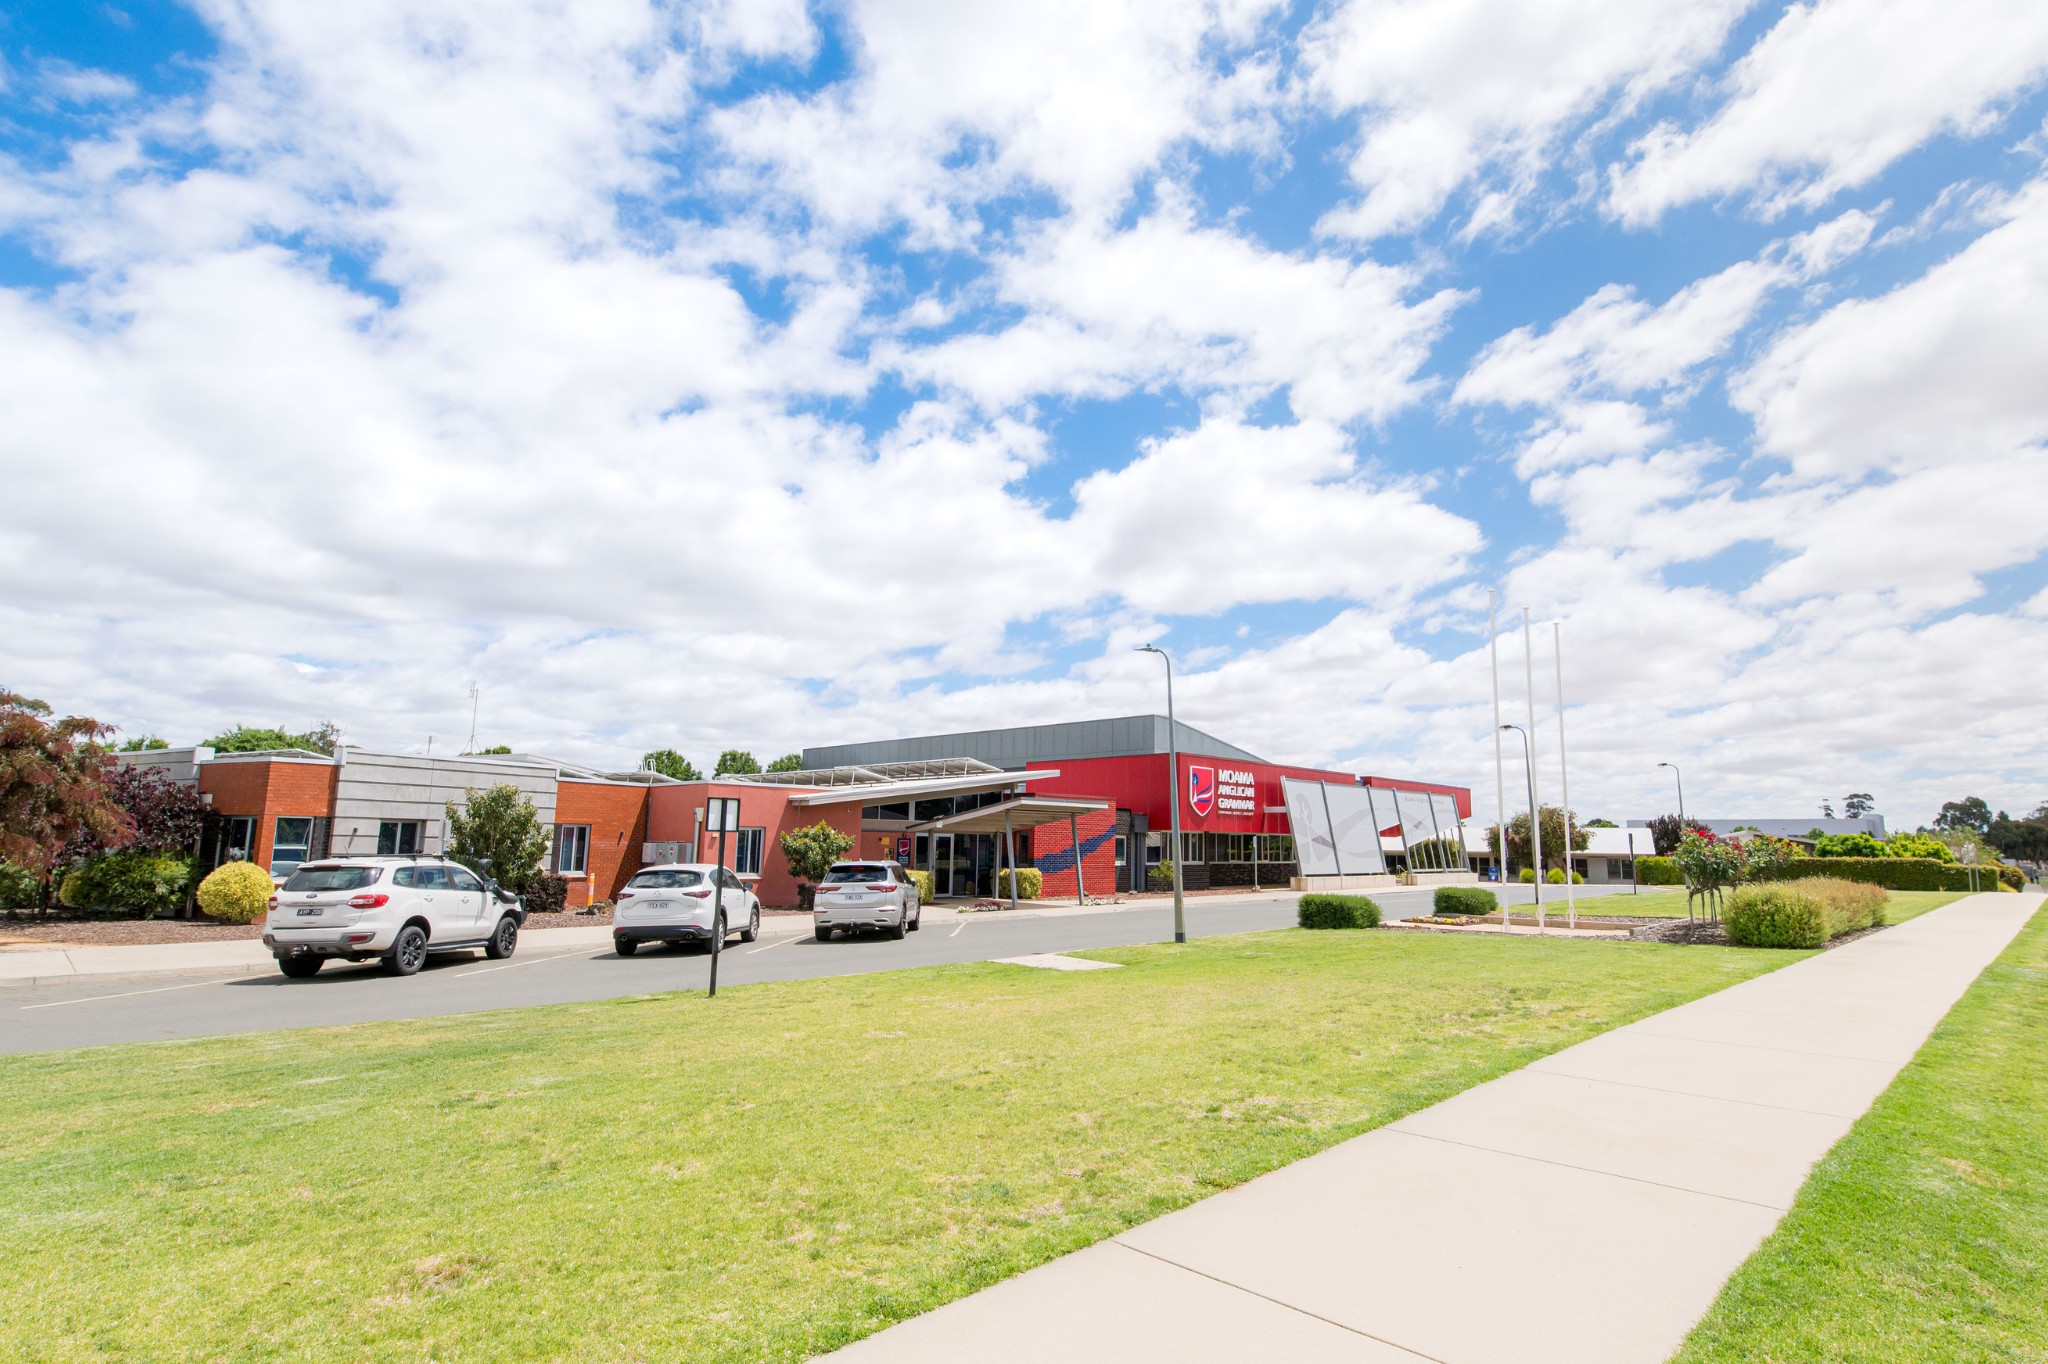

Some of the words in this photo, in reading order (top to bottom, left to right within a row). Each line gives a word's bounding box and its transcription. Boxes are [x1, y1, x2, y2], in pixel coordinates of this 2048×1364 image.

[1218, 769, 1254, 785] MOAMA
[1218, 785, 1254, 797] ANGLICAN
[1218, 798, 1255, 810] GRAMMAR
